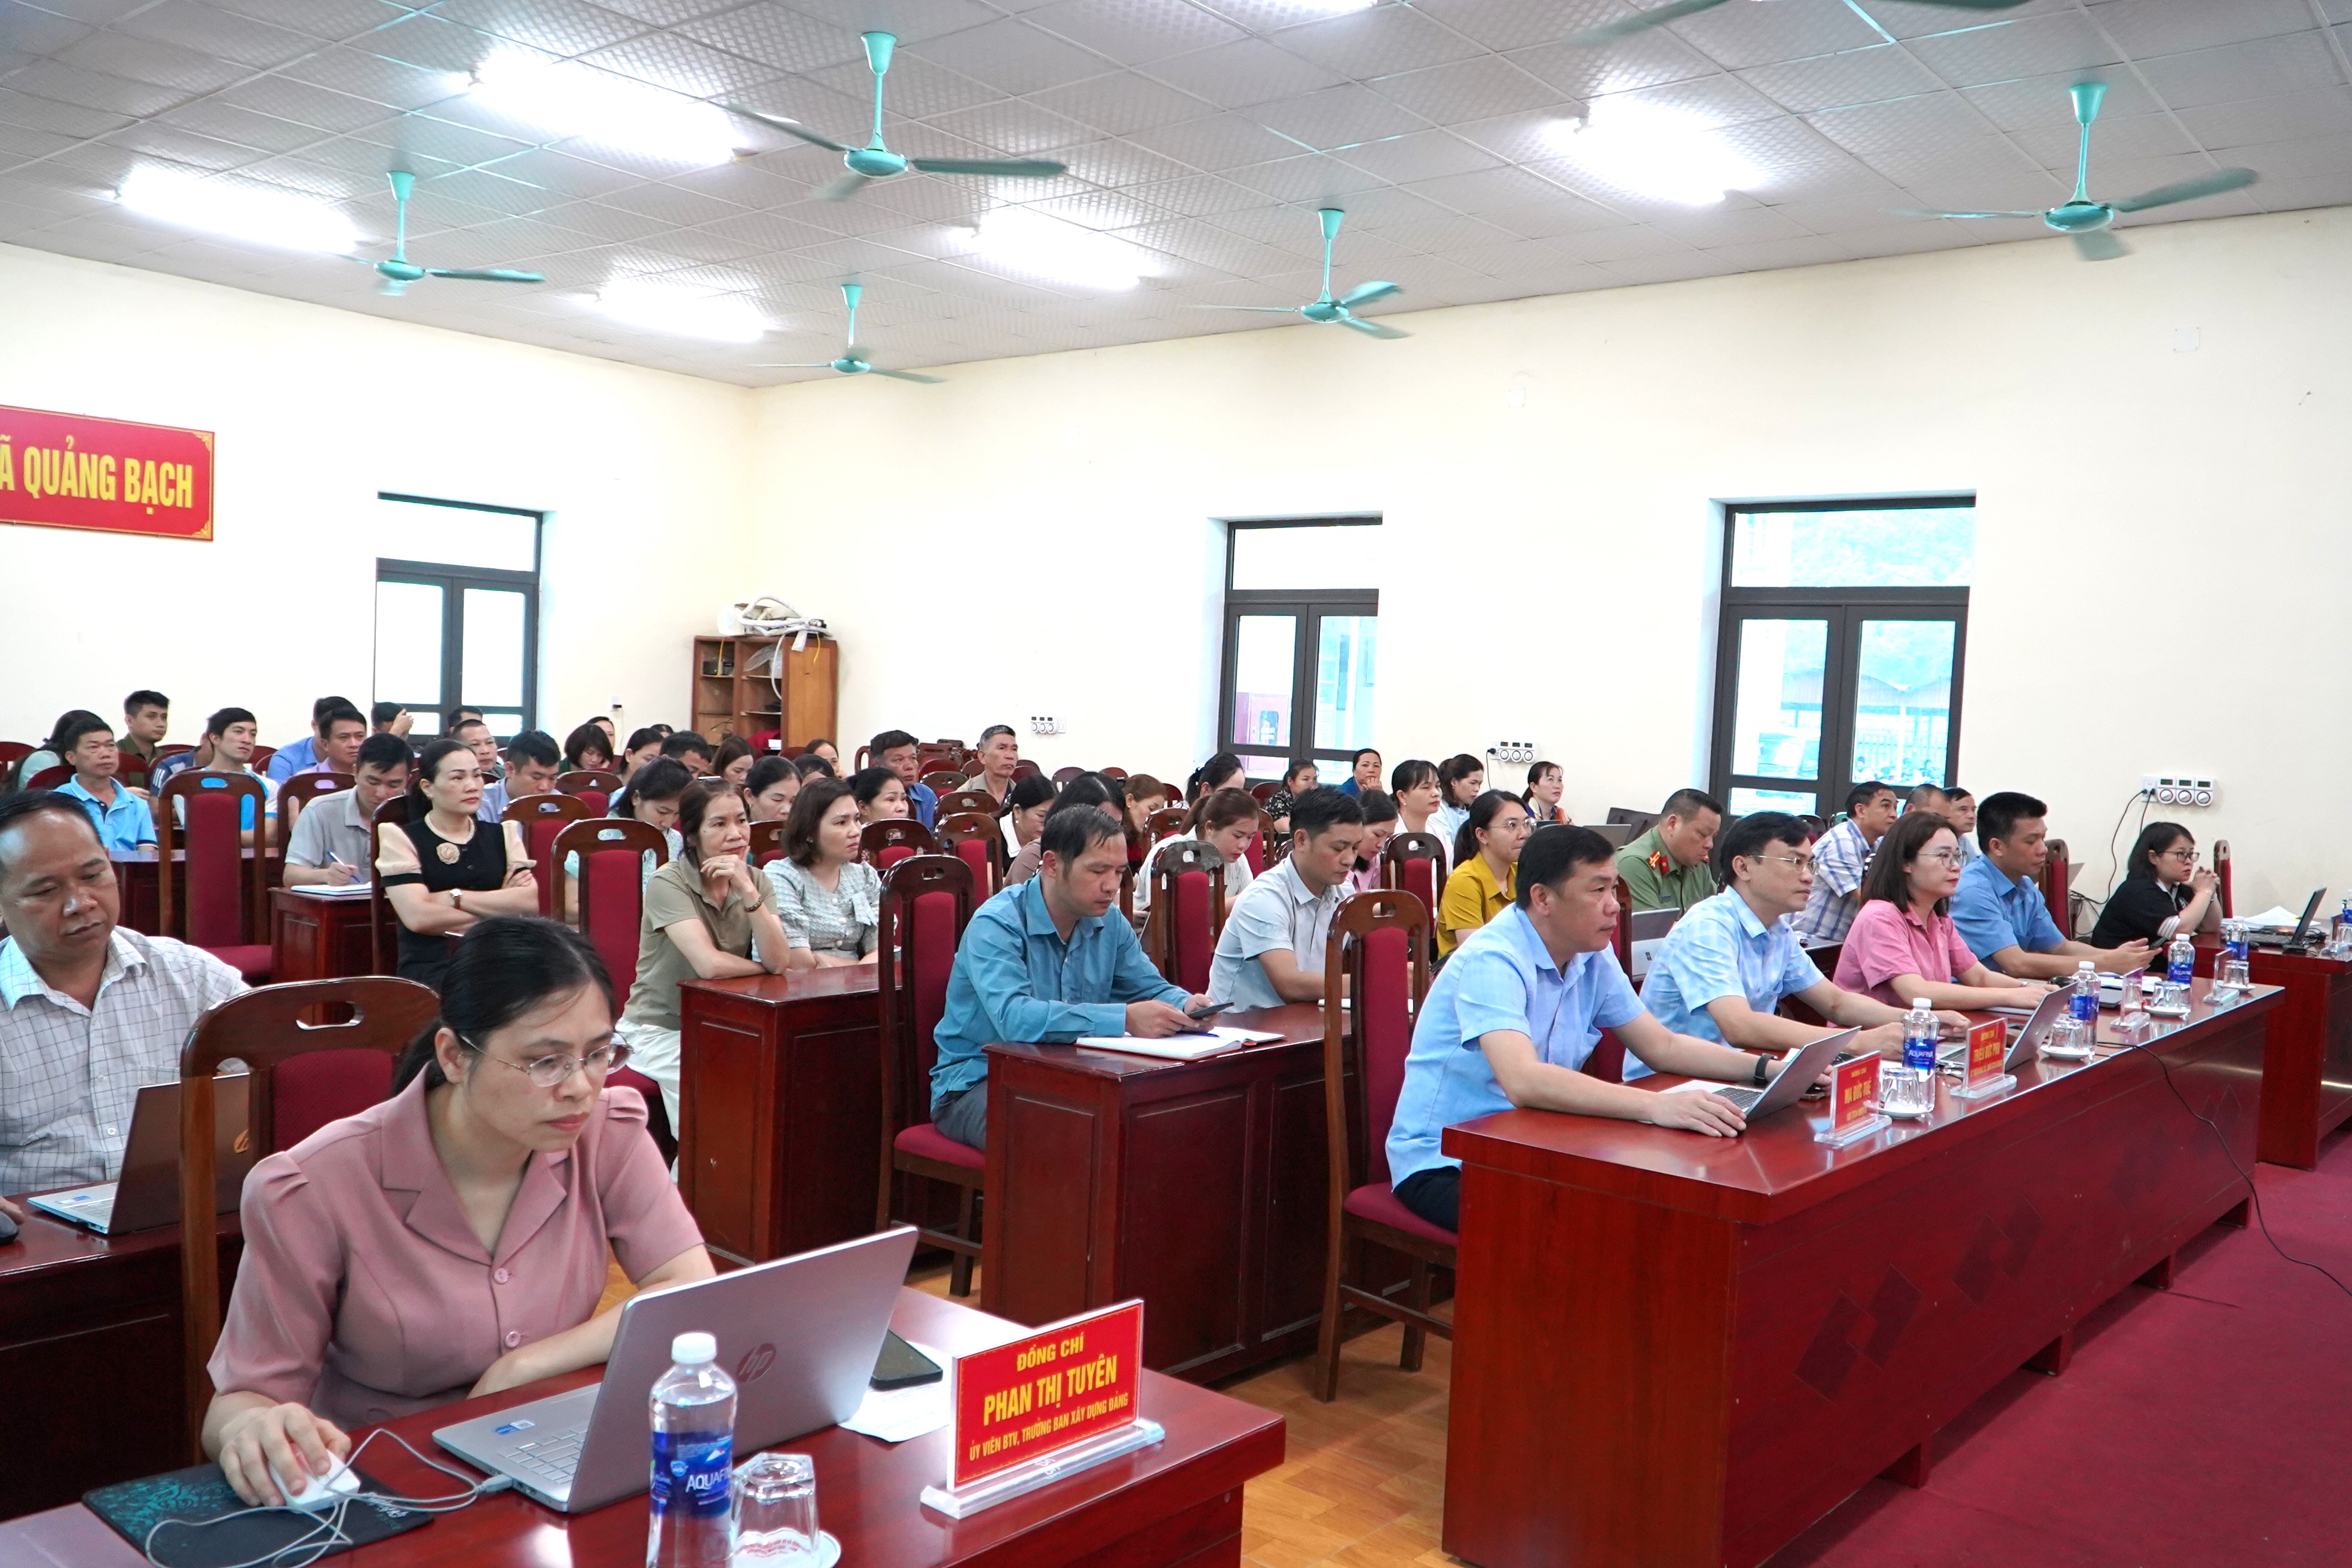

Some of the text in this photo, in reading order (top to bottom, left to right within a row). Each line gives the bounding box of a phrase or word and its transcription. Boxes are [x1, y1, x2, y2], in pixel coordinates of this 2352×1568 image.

[24, 435, 116, 501] QUẢNG
[124, 458, 192, 515] BẠCH
[737, 1344, 776, 1382] hp
[1061, 1331, 1084, 1357] CHÍ
[984, 1353, 1117, 1426] PHAN THỊ TUYÊN
[1054, 1413, 1069, 1431] BAN
[1071, 1405, 1085, 1425] XÂY
[1087, 1399, 1107, 1420] DỰNG
